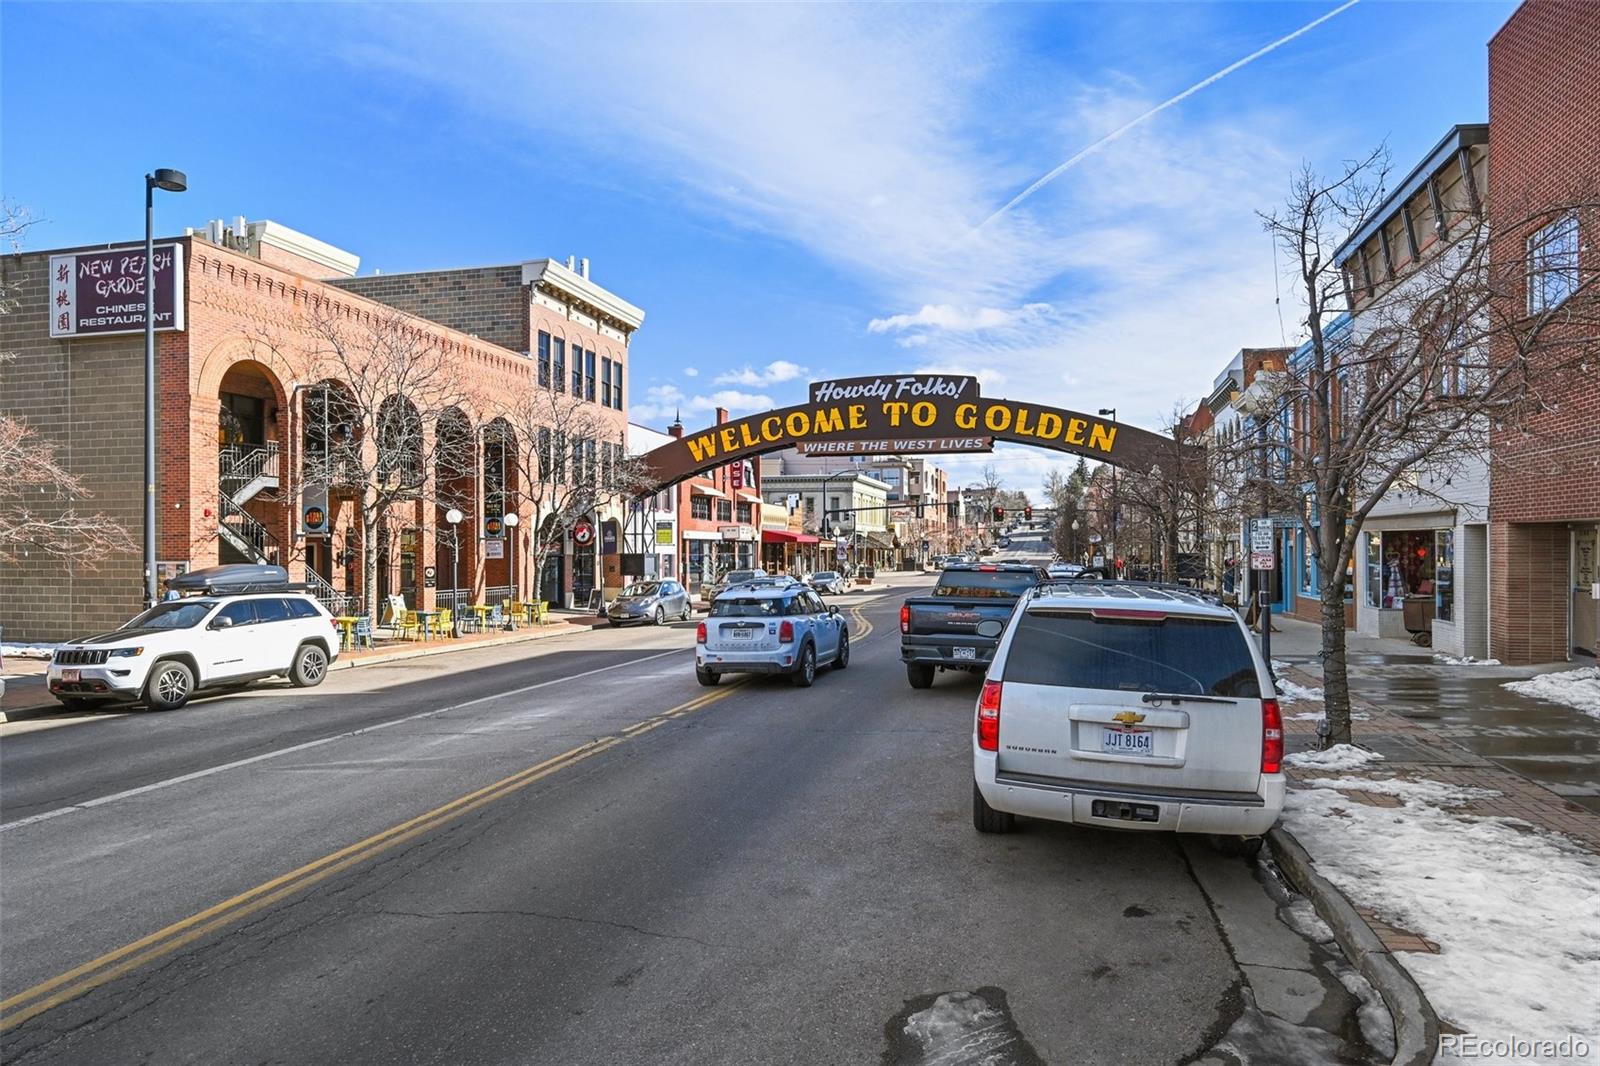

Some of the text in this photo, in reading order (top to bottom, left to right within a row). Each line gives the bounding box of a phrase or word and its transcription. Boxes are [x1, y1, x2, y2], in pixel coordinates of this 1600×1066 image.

[79, 259, 113, 279] NEW
[95, 303, 153, 315] CHINES
[815, 376, 968, 402] Howdy Folks!
[687, 401, 1118, 463] WELCOME TO GOLDEN
[803, 438, 984, 453] WHERE THE WEST LIVES
[1105, 733, 1149, 749] JJT 8164
